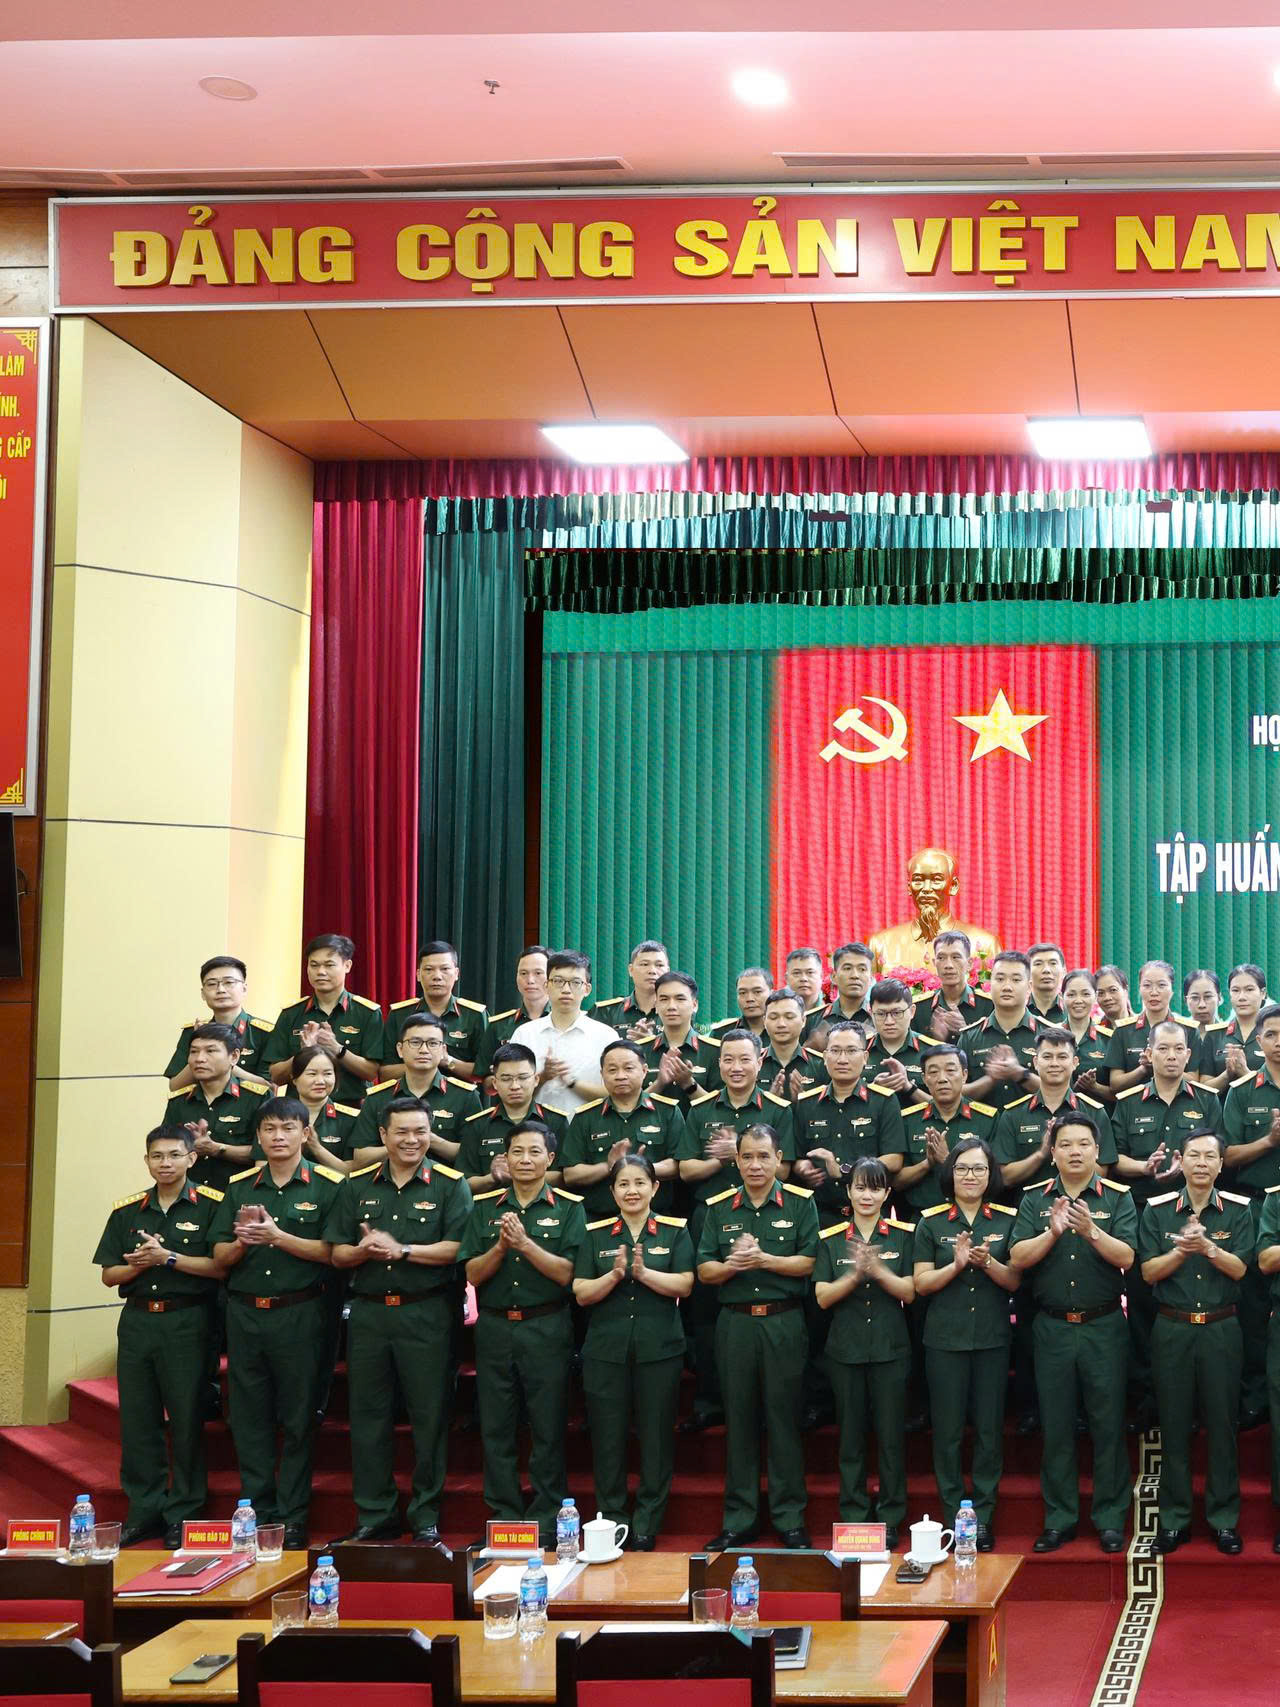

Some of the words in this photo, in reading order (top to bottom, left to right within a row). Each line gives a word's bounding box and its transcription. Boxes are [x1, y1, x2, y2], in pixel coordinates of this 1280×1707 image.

[109, 205, 354, 288] ĐẢNG
[397, 207, 636, 293] CỘNG
[673, 196, 860, 278] SẢN
[893, 200, 1079, 285] VIỆT
[7, 429, 32, 457] CẤP
[1156, 831, 1207, 904] TẬP
